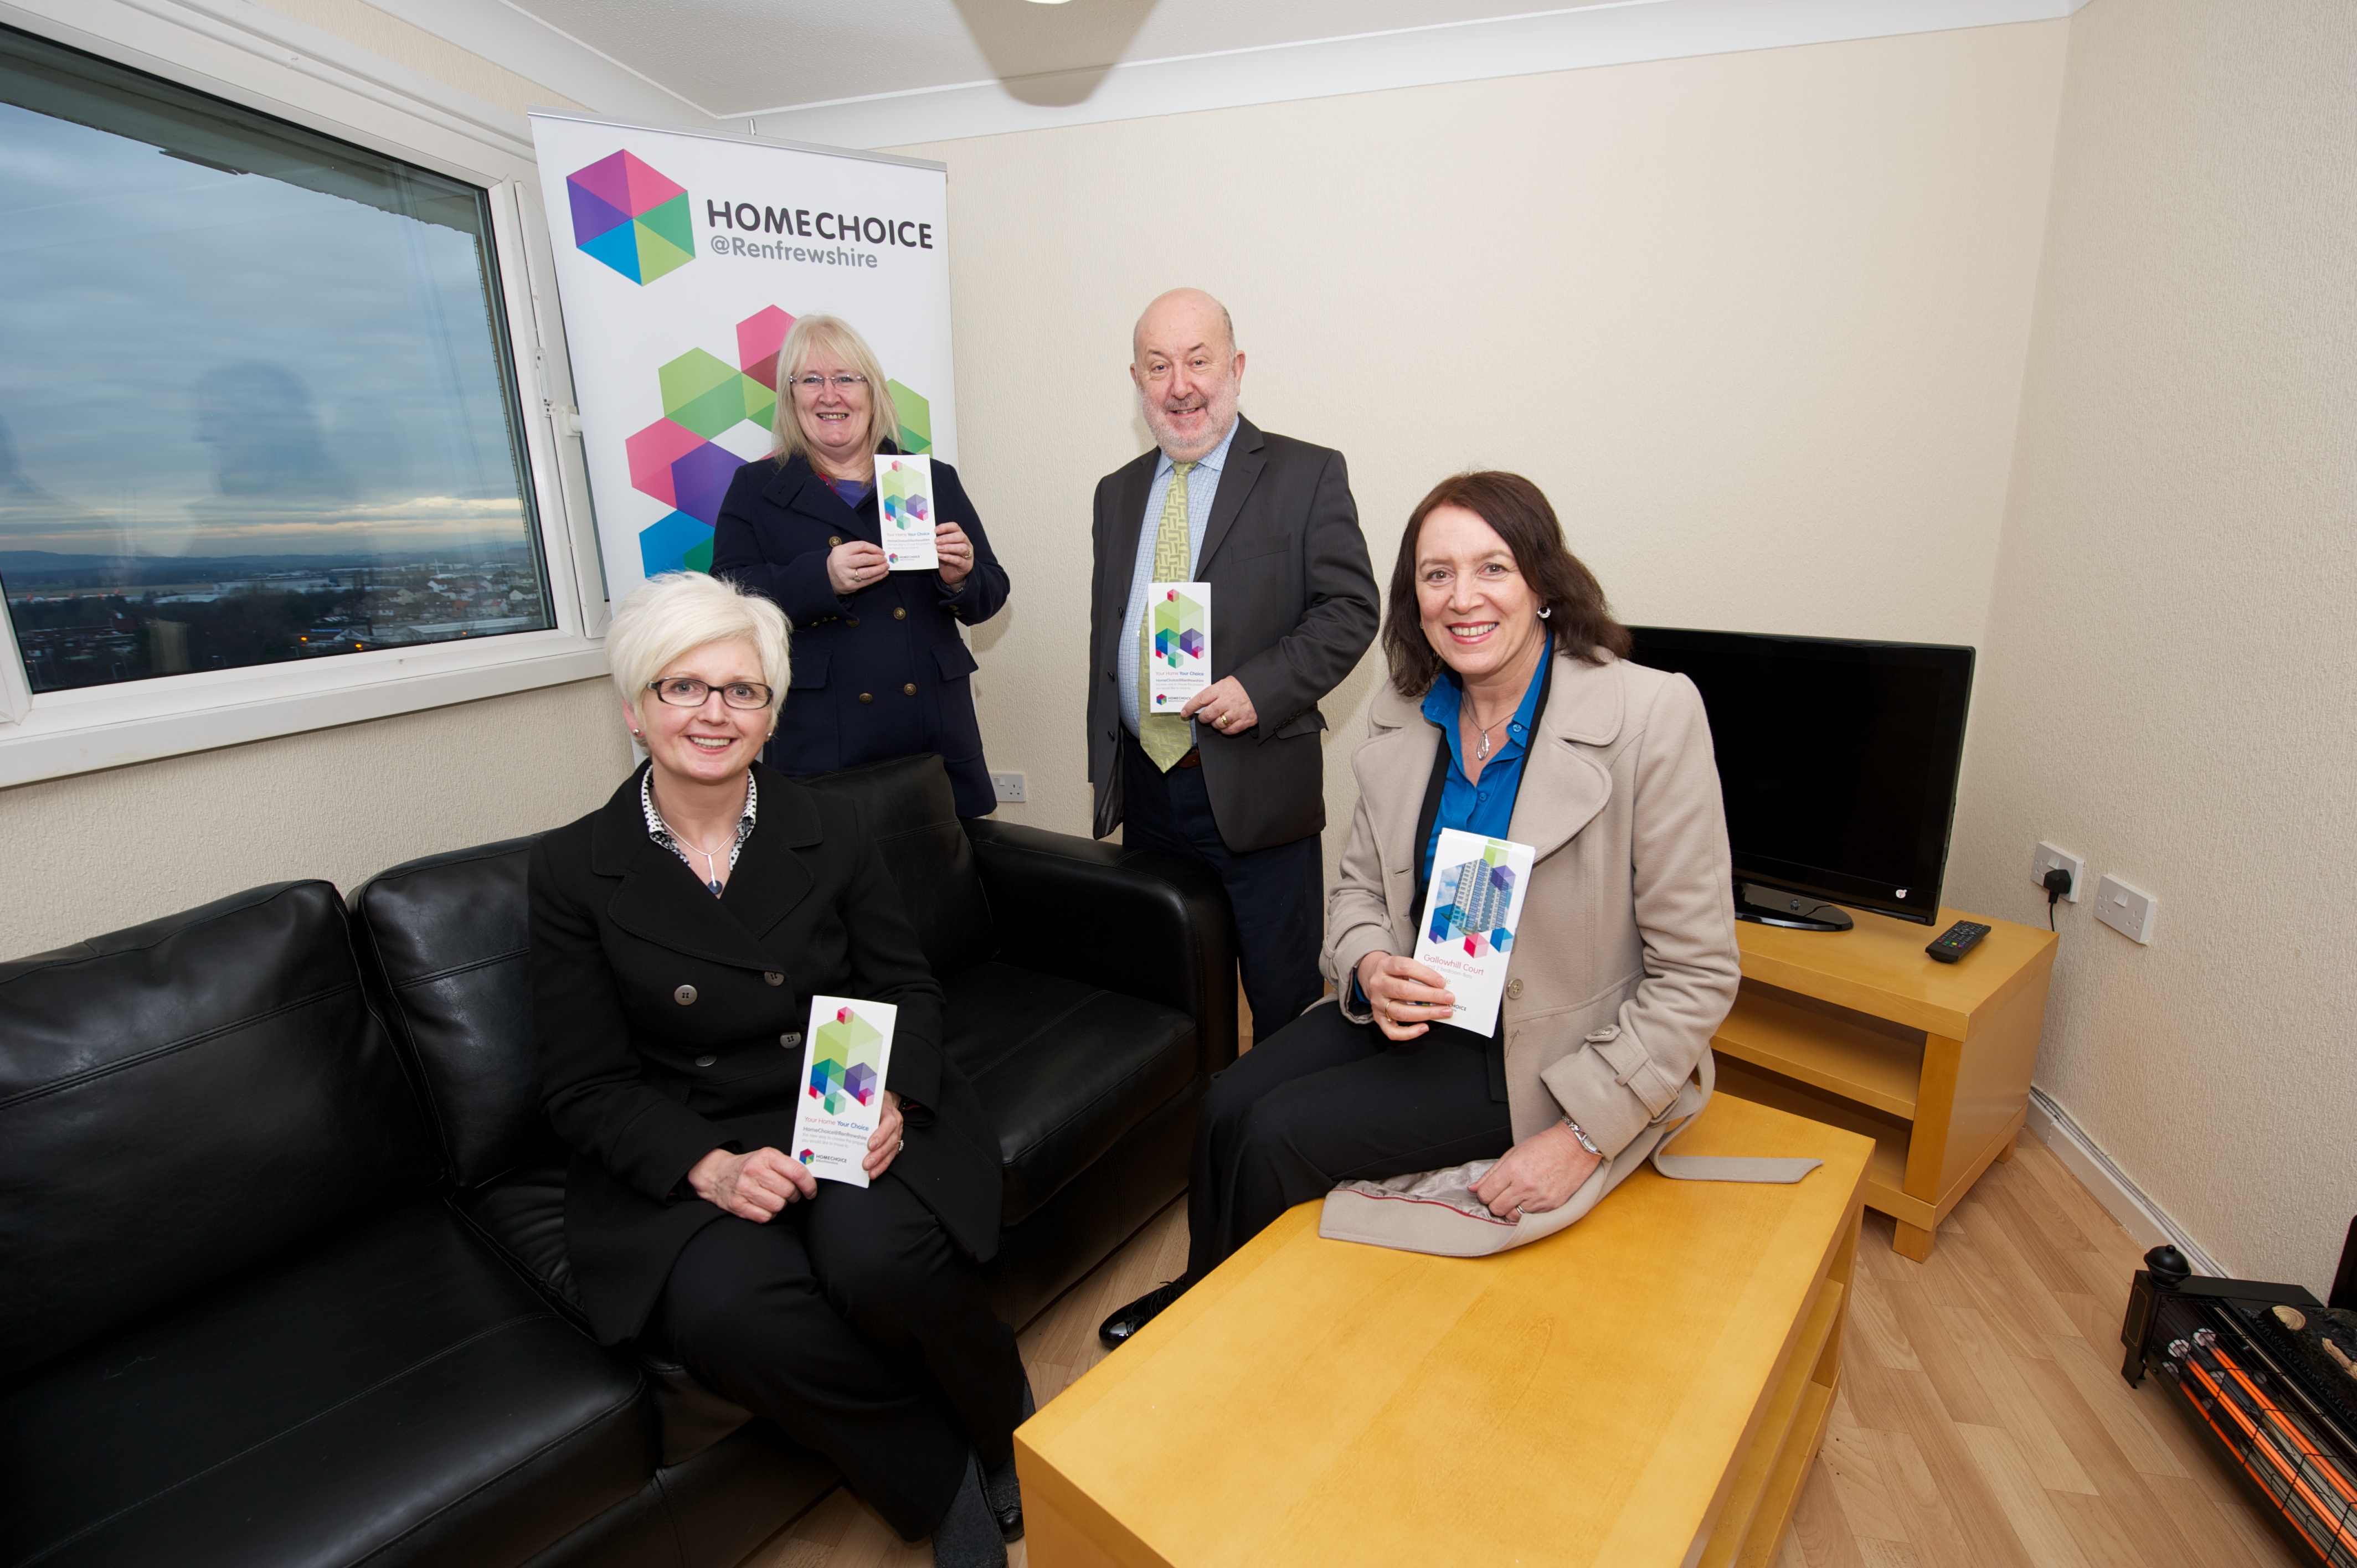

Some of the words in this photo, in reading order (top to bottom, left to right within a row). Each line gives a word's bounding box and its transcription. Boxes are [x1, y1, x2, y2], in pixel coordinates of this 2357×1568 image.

[707, 199, 933, 249] HOMECHOICE
[711, 235, 878, 268] @Renfrewshire
[1424, 954, 1461, 969] Gallowhill
[1463, 963, 1484, 976] Court
[1440, 967, 1461, 976] bedroom
[803, 1126, 867, 1141] HomeChoice@Renfrewshire
[851, 1122, 869, 1131] Choice
[816, 1154, 847, 1163] HOMECHOICE
